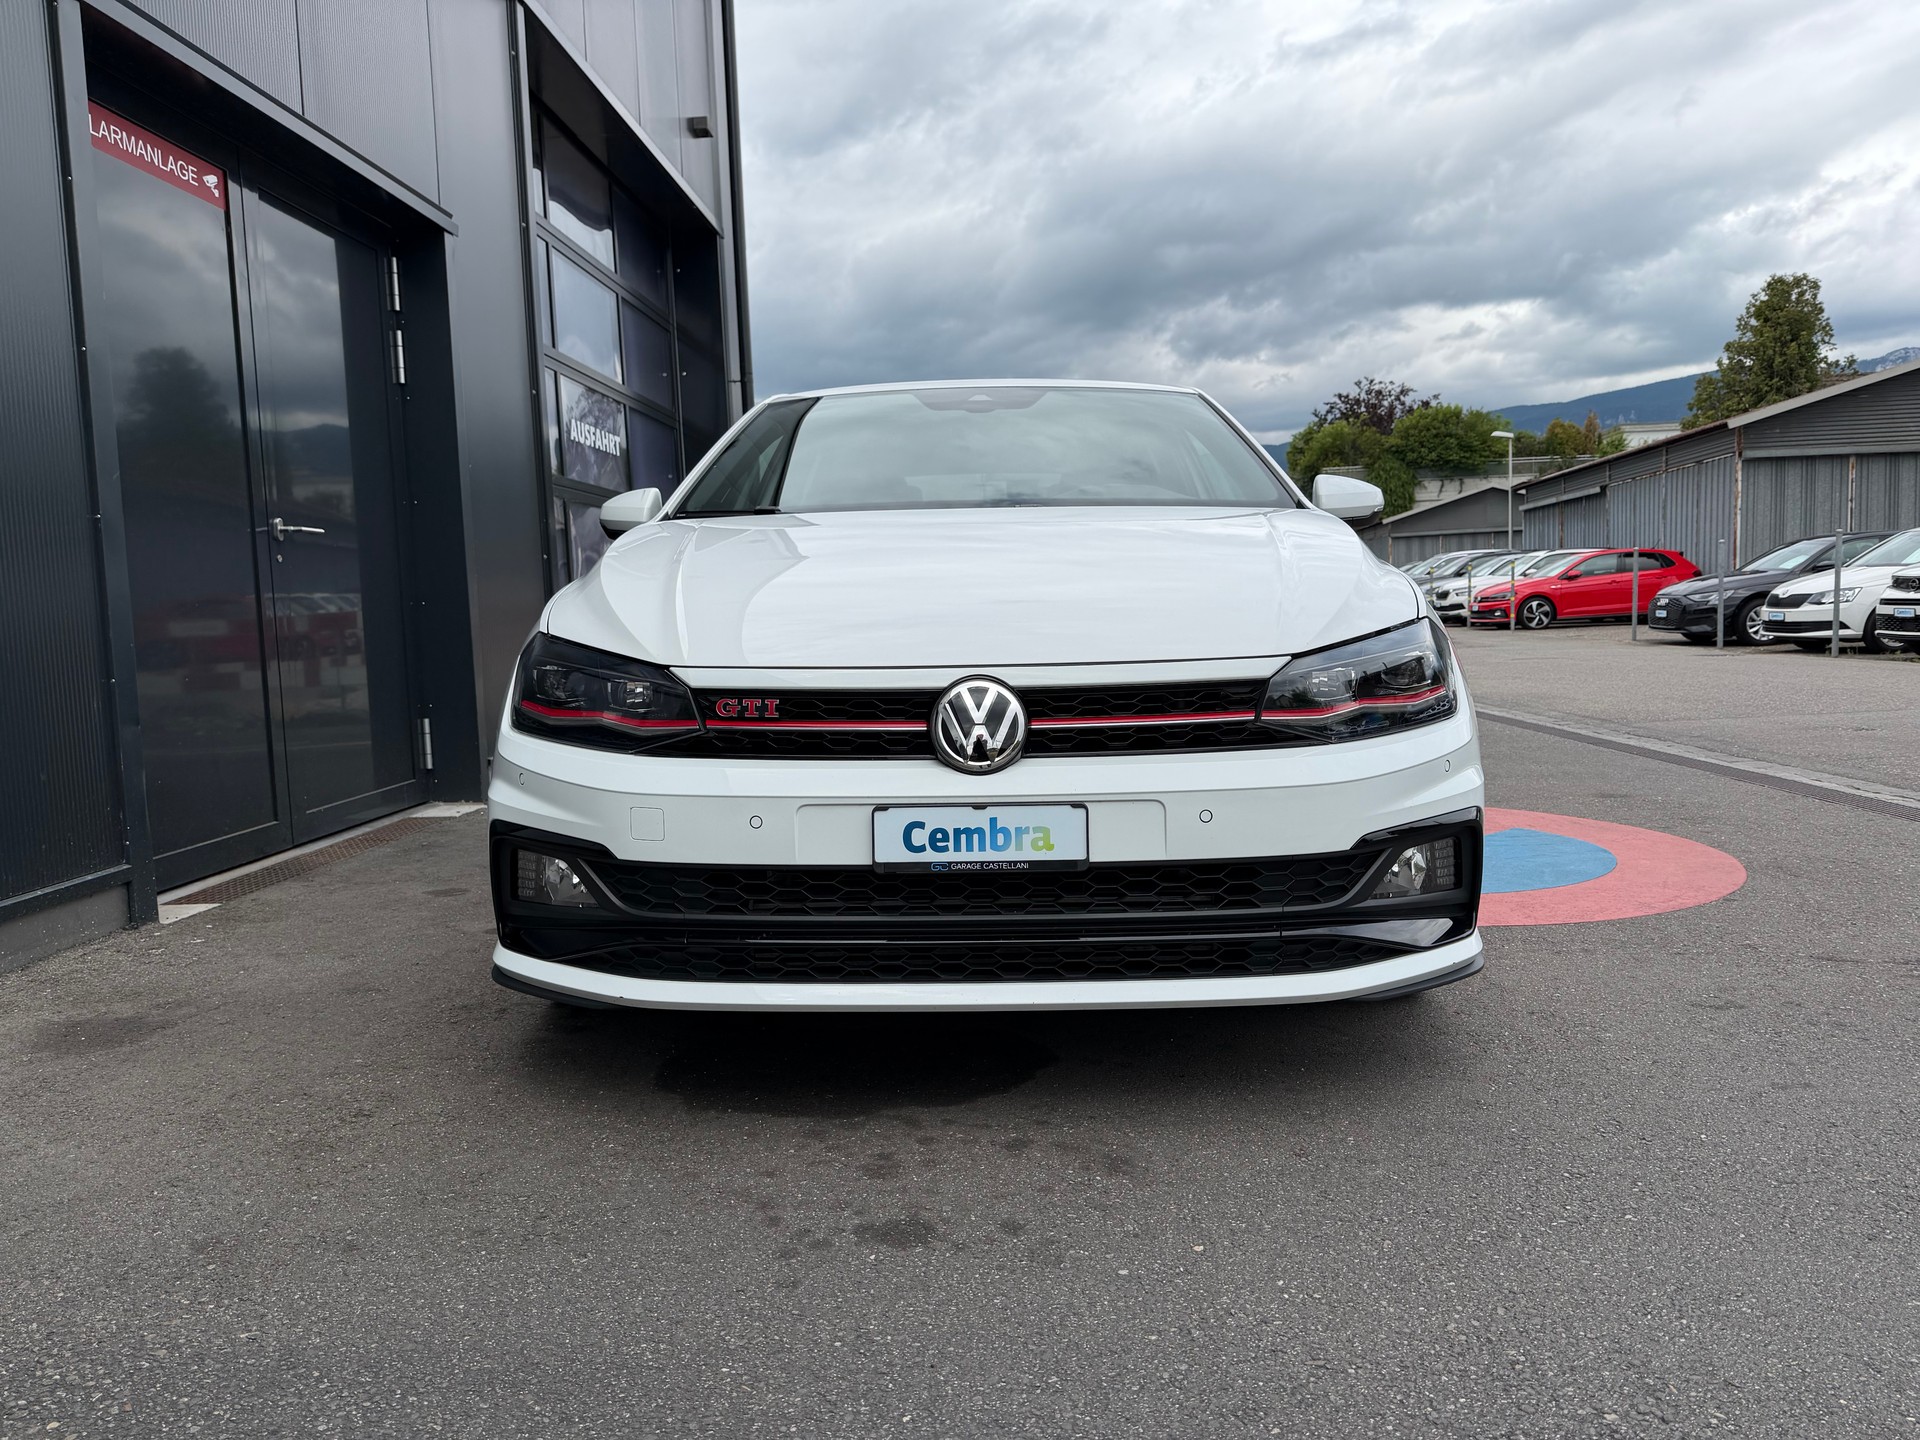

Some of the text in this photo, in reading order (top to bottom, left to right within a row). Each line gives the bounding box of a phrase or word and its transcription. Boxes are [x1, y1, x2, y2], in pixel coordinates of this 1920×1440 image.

[88, 113, 199, 186] LARMANLAGE
[570, 418, 621, 457] AUSFAHRT
[715, 698, 780, 718] GTI
[902, 816, 1055, 854] Cembra
[950, 862, 982, 870] GARAGE
[983, 862, 1029, 870] CASTELLANI
